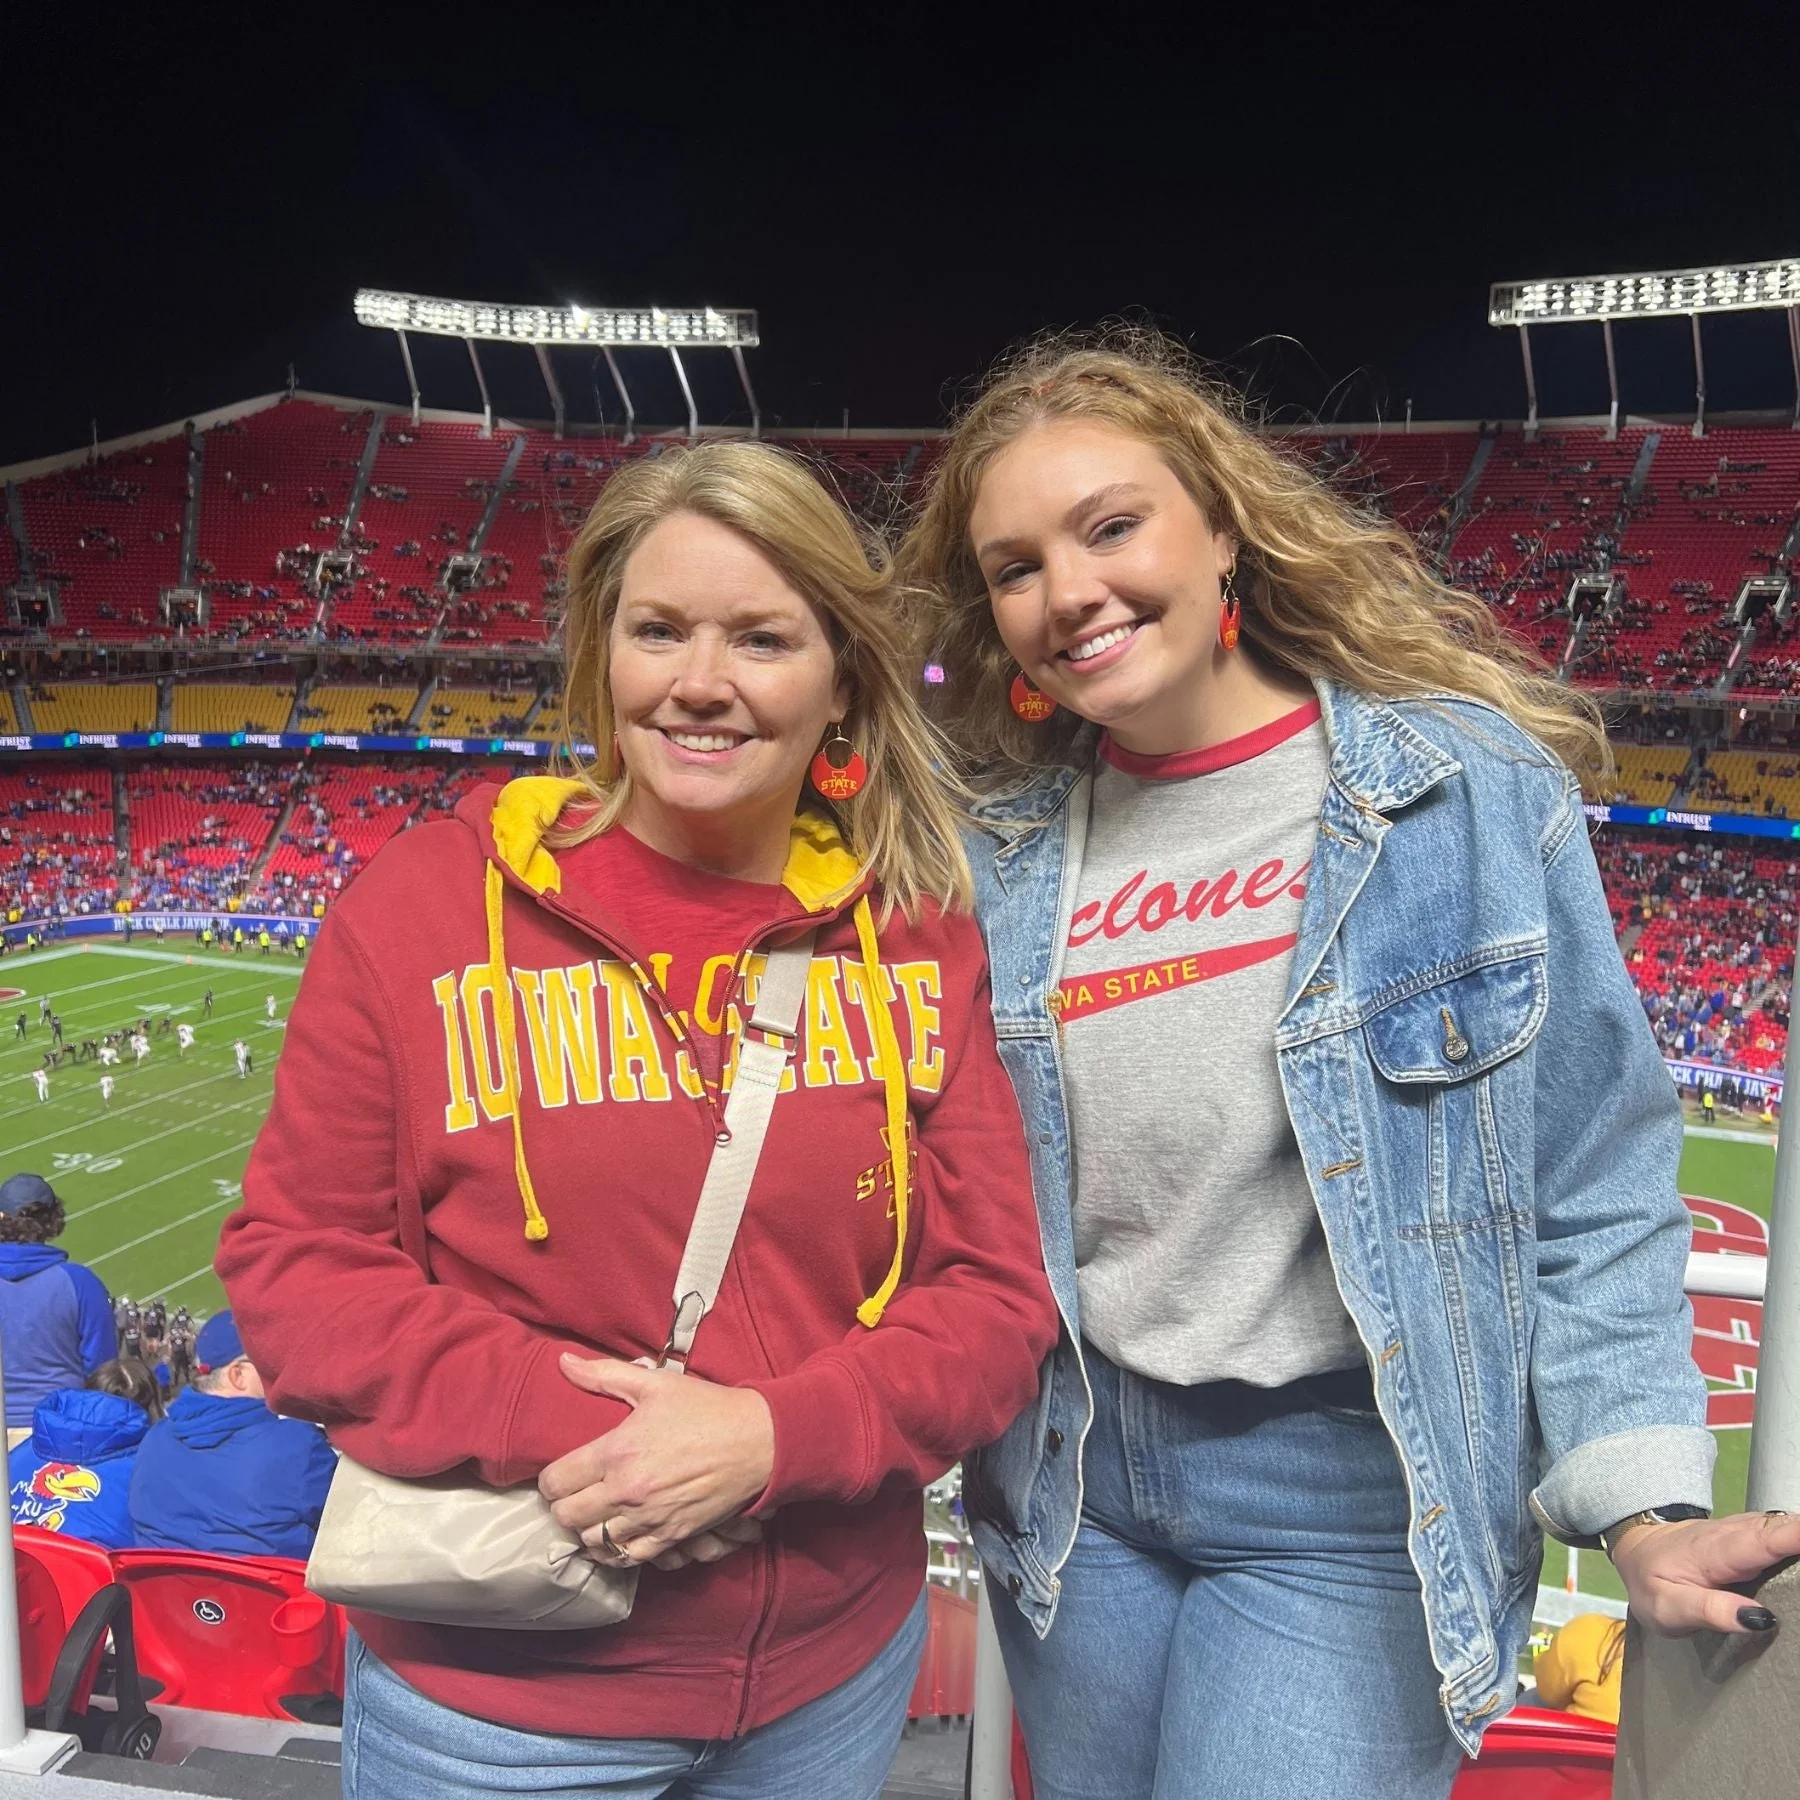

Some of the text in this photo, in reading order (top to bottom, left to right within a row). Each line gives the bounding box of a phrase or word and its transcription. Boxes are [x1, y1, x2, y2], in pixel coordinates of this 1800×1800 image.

[821, 778, 857, 790] STATE
[1104, 958, 1200, 999] STATE
[432, 958, 672, 1134] IOWA
[20, 1500, 43, 1518] KU
